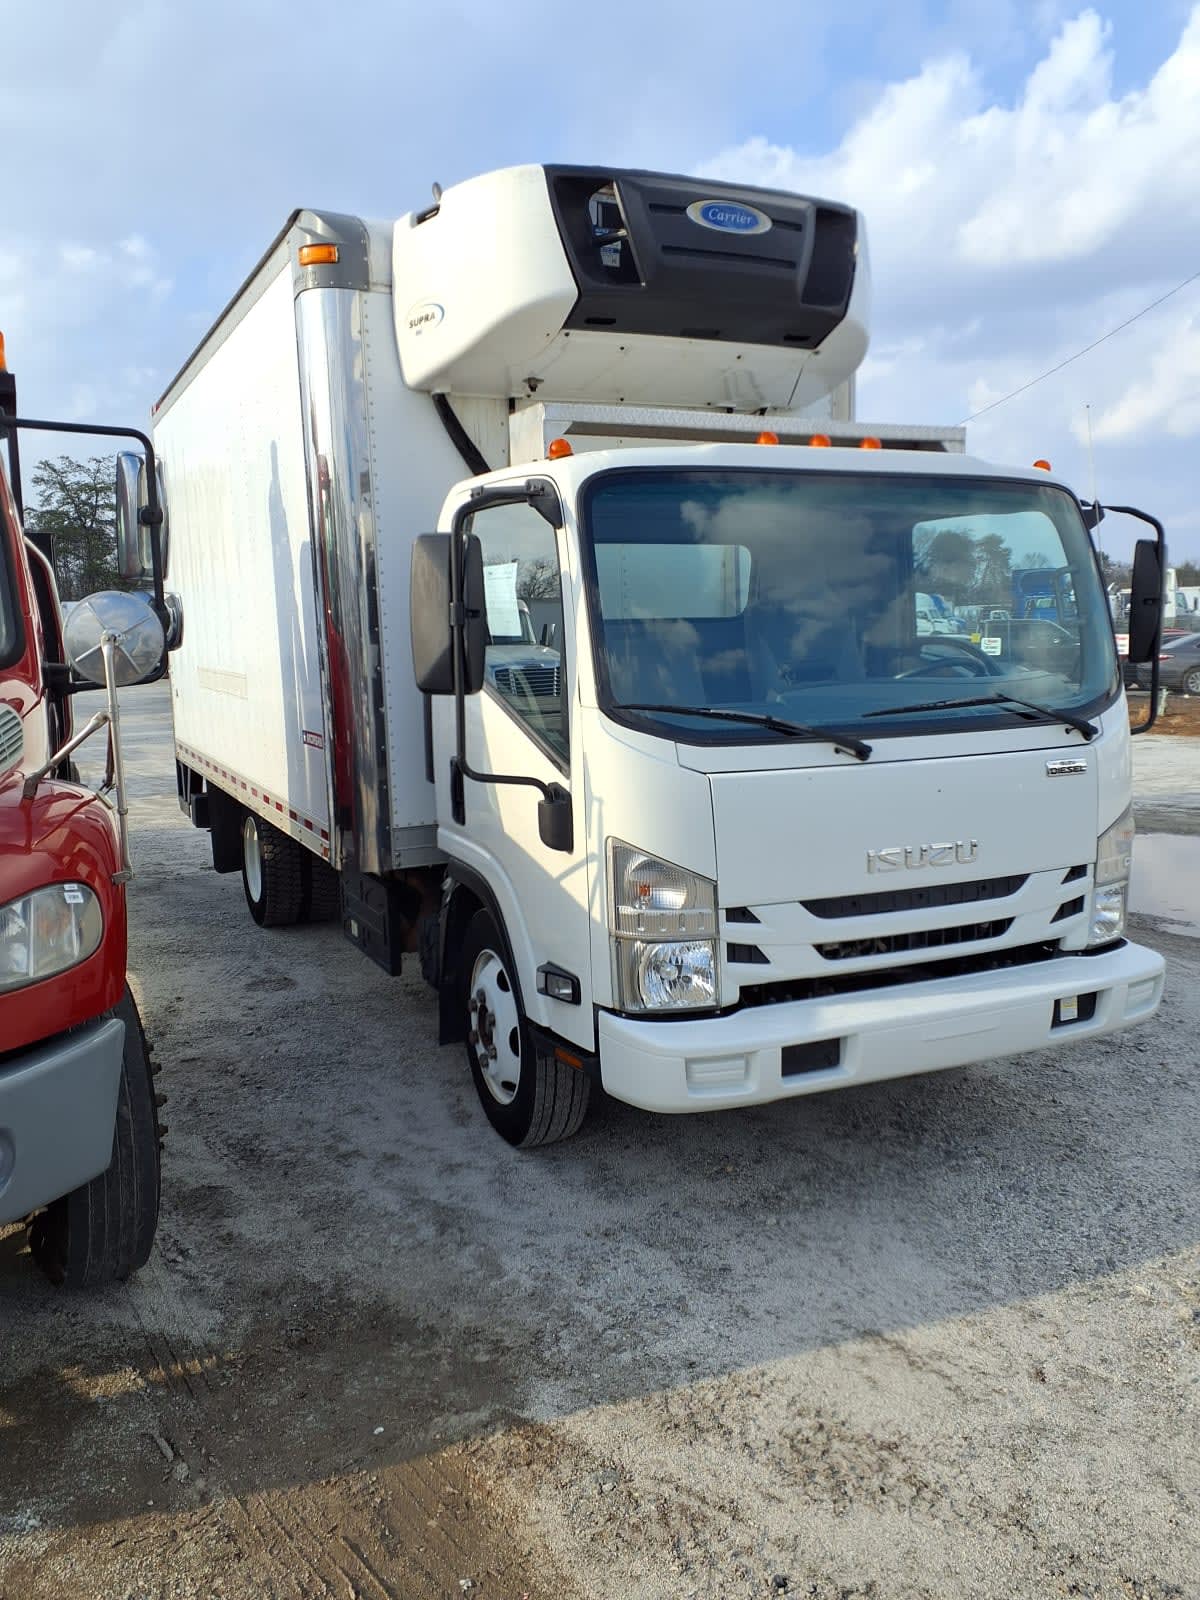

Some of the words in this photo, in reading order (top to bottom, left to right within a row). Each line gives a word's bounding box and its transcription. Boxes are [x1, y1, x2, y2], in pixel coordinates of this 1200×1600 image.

[708, 207, 753, 225] Carrier
[408, 311, 436, 329] SUPRA
[1049, 766, 1087, 775] DIESEL
[866, 839, 978, 874] ISUZU
